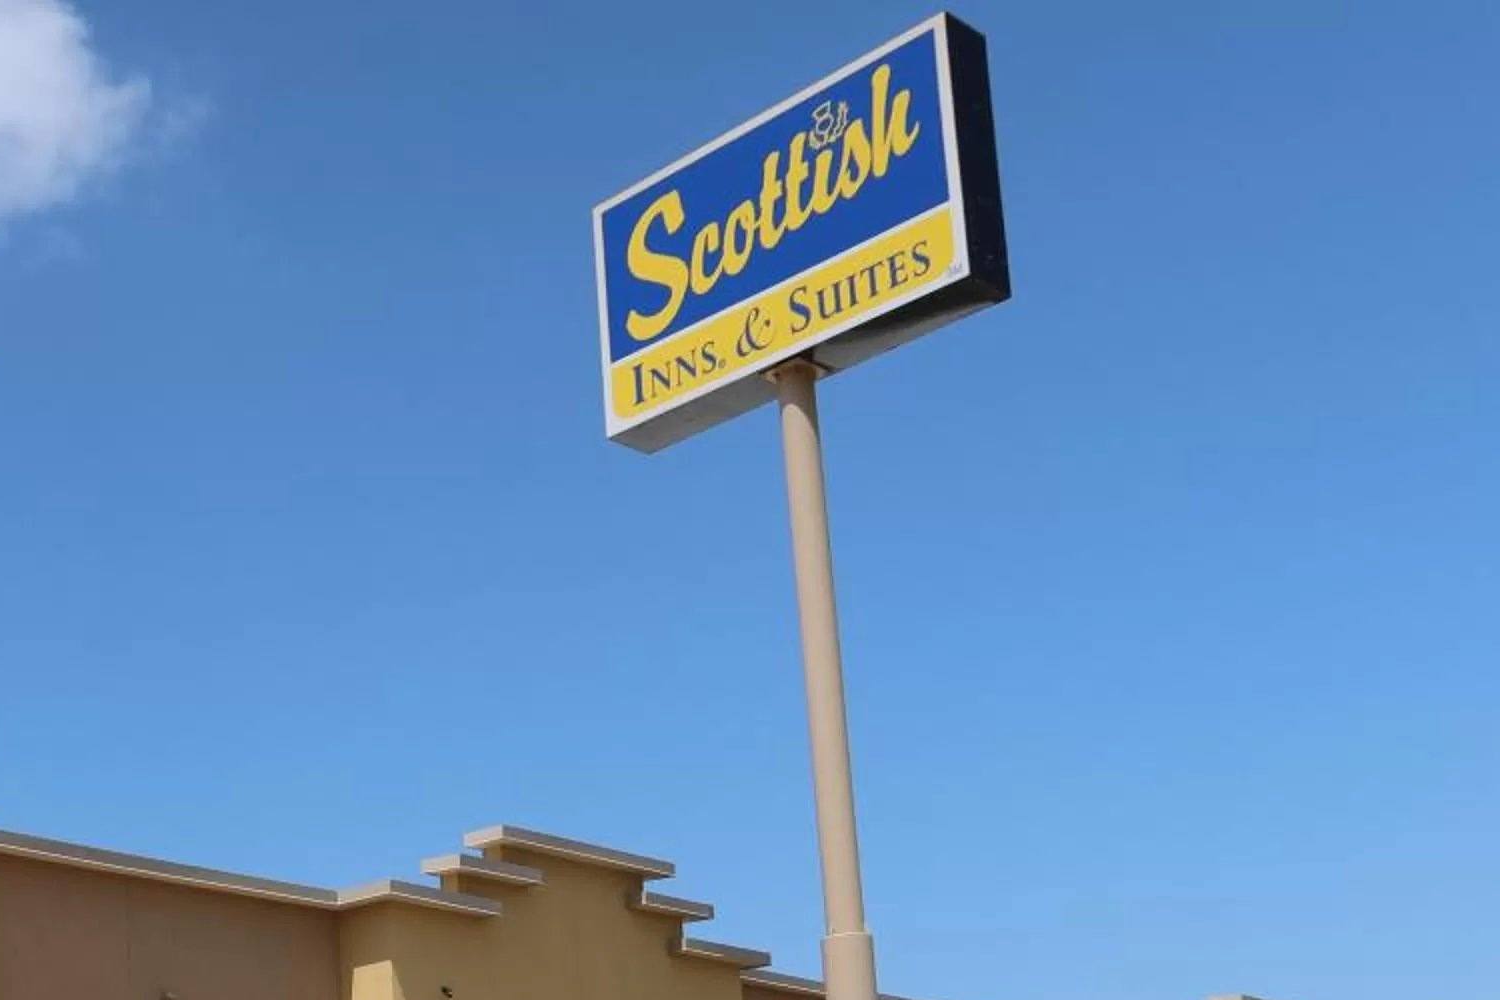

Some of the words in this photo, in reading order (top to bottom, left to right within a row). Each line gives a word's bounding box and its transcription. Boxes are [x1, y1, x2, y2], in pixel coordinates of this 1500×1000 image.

[626, 63, 920, 341] Scottish
[736, 306, 776, 358] &
[788, 240, 931, 336] SUITES
